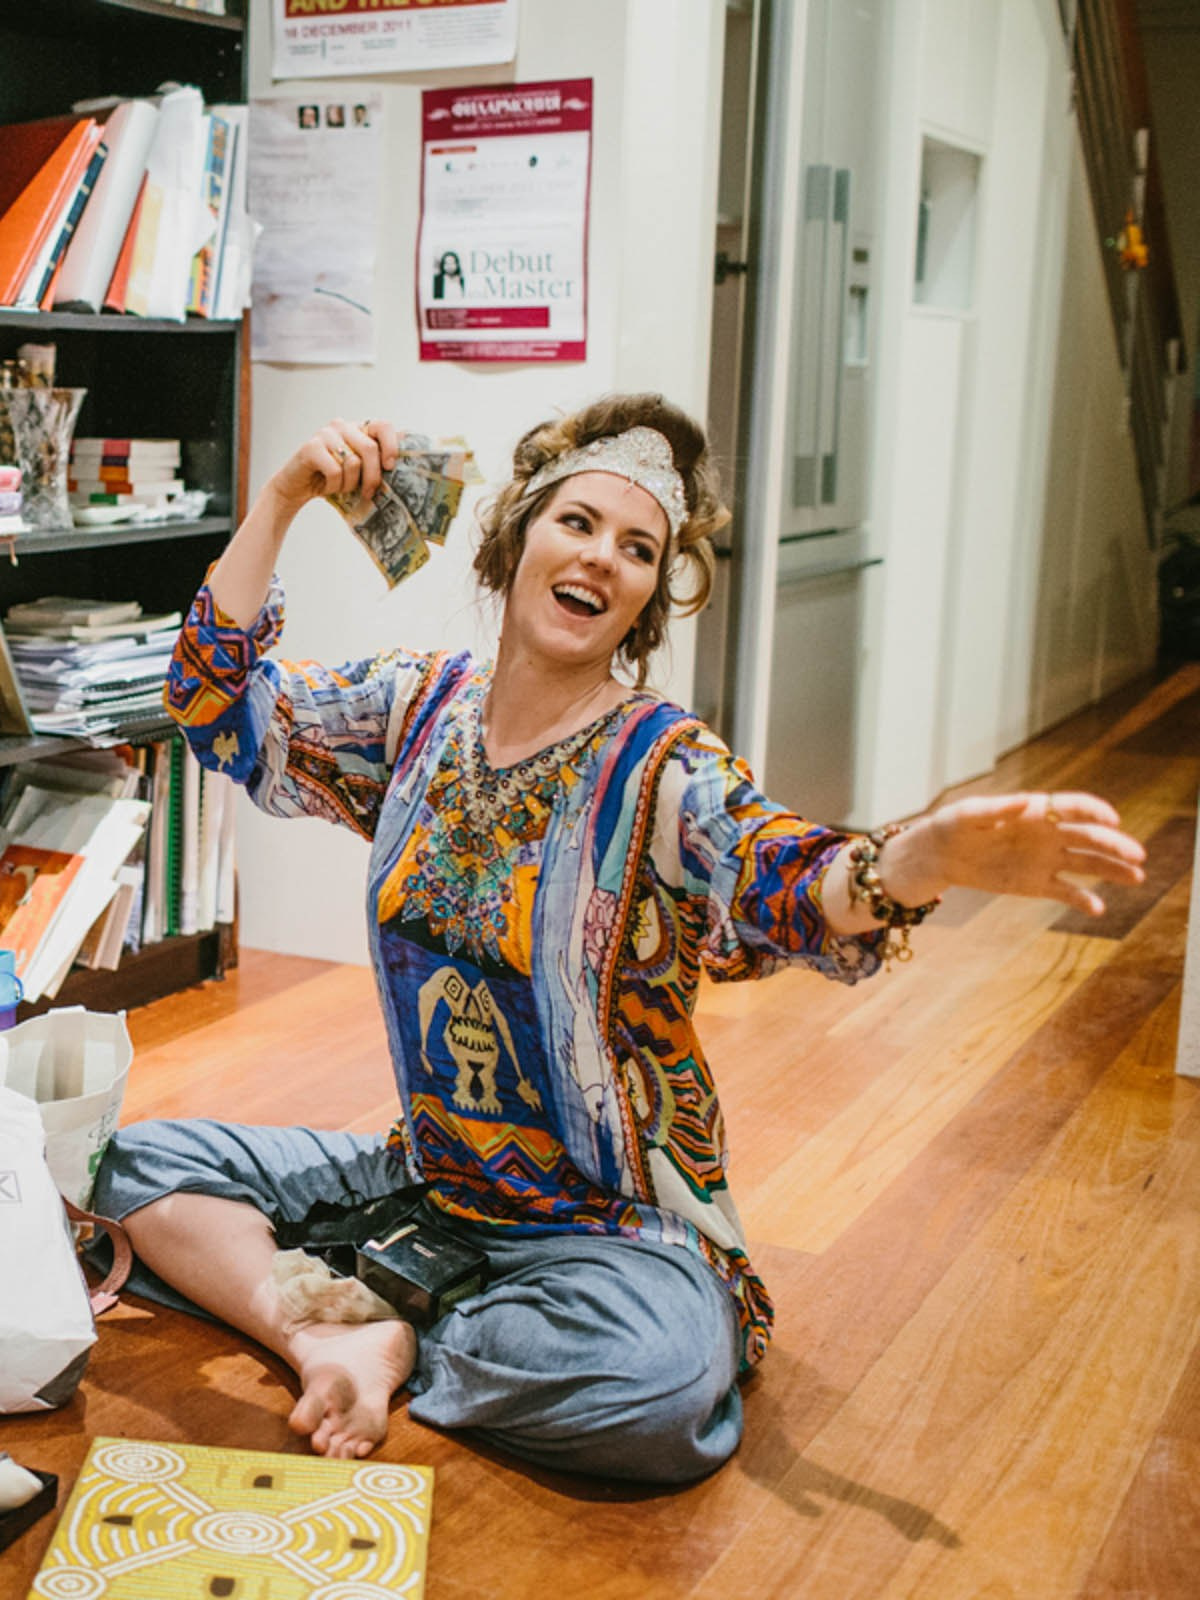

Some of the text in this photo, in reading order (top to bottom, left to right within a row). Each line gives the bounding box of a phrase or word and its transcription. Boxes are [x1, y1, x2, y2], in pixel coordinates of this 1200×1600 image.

[301, 21, 378, 38] DECEMBER
[470, 250, 553, 275] Debut
[485, 276, 575, 300] Master
